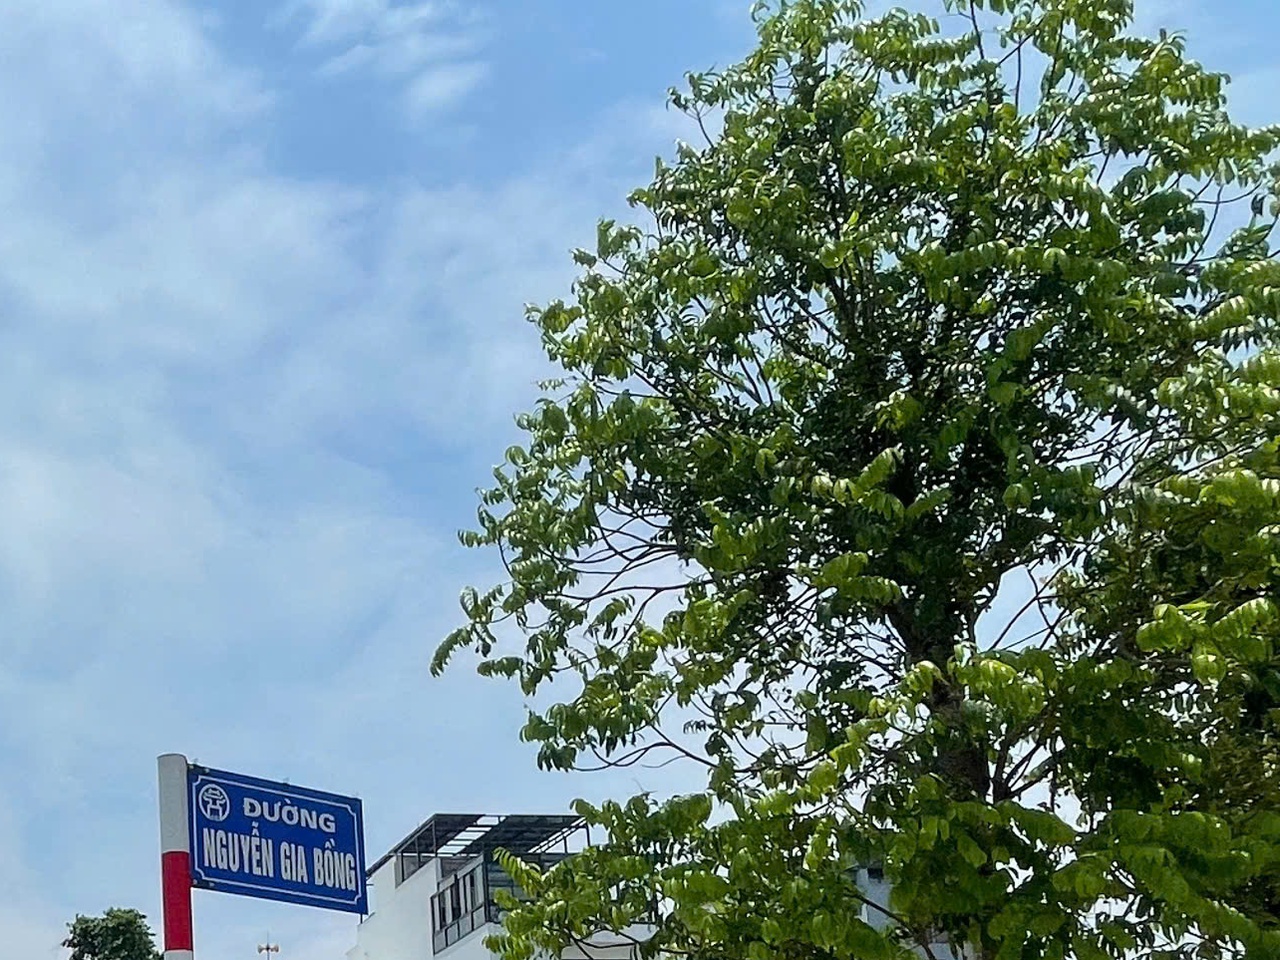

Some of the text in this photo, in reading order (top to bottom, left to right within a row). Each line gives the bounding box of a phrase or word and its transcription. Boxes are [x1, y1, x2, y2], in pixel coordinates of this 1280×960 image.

[242, 797, 337, 834] ĐƯỜNG
[202, 821, 357, 892] NGUYỄN GIA BỒNG
